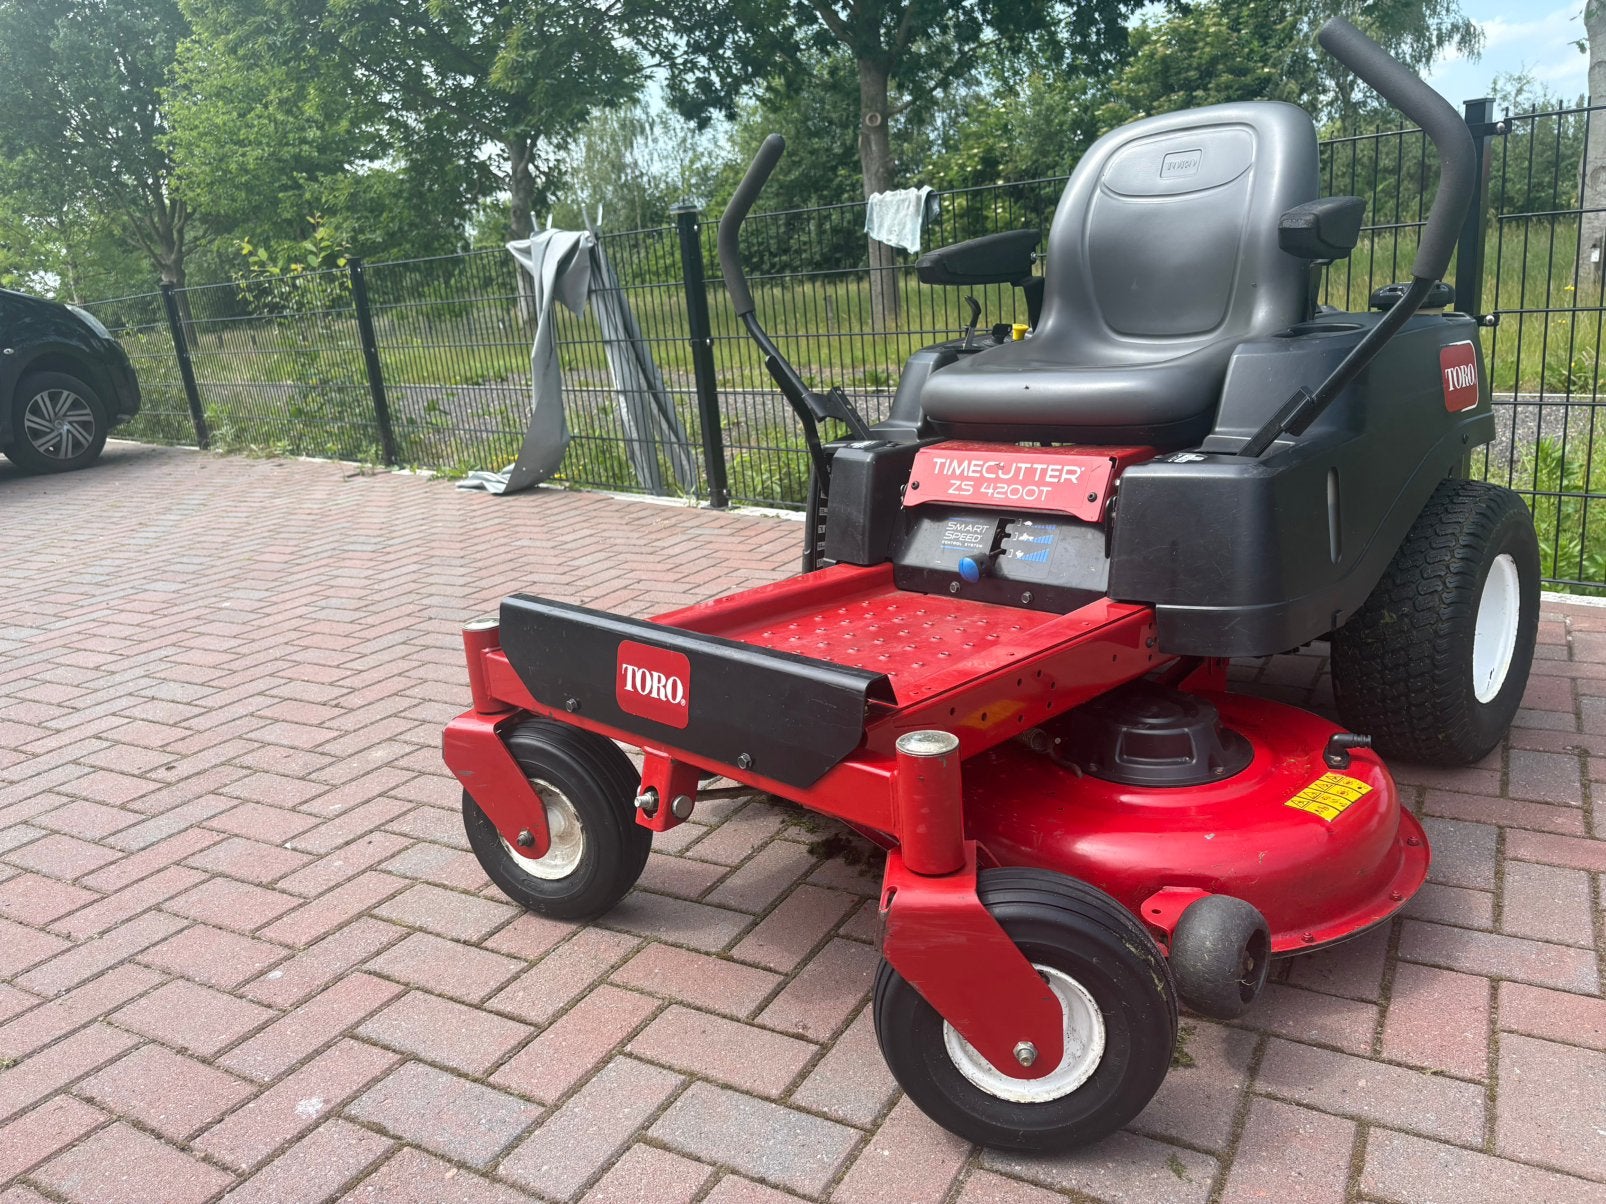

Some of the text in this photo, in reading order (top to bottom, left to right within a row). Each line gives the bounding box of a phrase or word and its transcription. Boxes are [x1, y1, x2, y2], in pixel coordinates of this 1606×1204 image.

[1445, 363, 1475, 391] TORO
[933, 458, 1081, 484] TIMECUTTER
[948, 480, 1052, 501] ZS 4200T
[943, 530, 981, 542] SPEED
[946, 521, 990, 533] SMART
[621, 663, 684, 705] TORO
